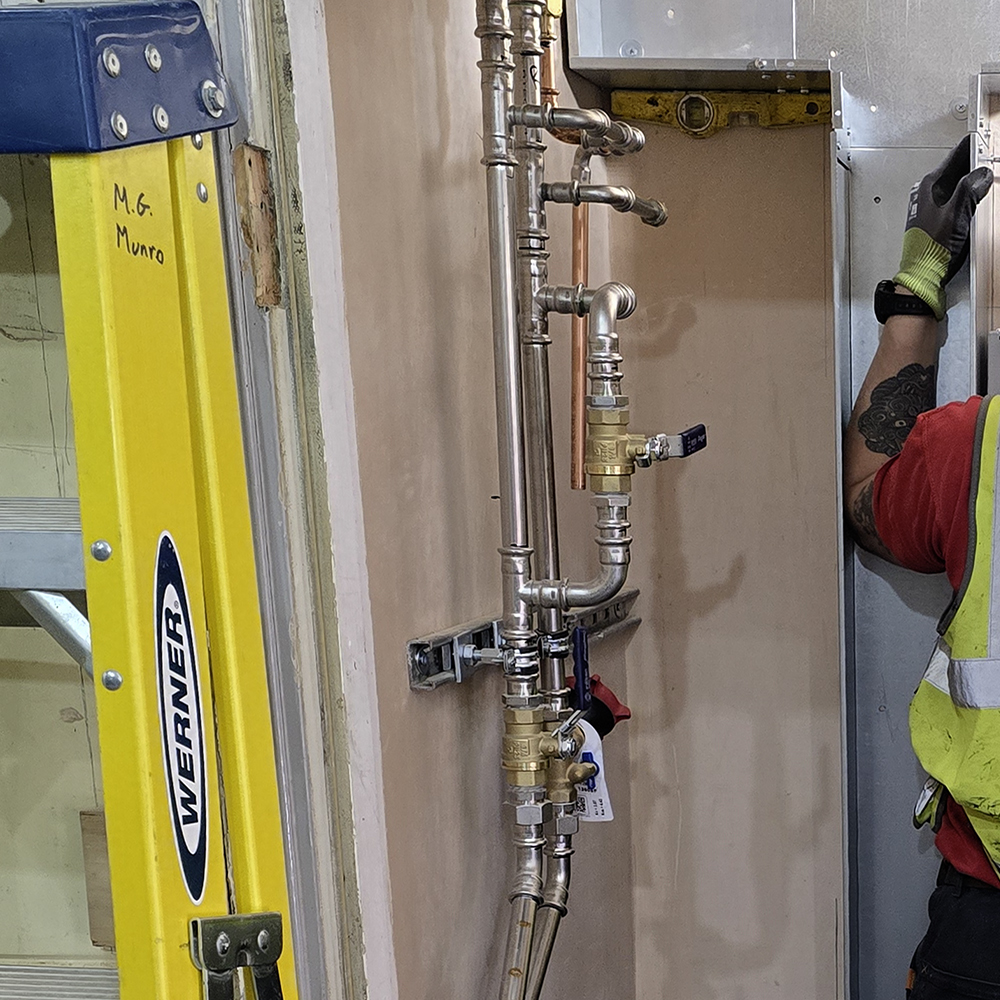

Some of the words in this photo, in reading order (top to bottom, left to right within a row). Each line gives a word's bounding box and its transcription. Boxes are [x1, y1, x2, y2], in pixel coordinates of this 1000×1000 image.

[113, 182, 153, 216] M.G.
[116, 222, 165, 265] Munro
[164, 609, 199, 826] WERNER
